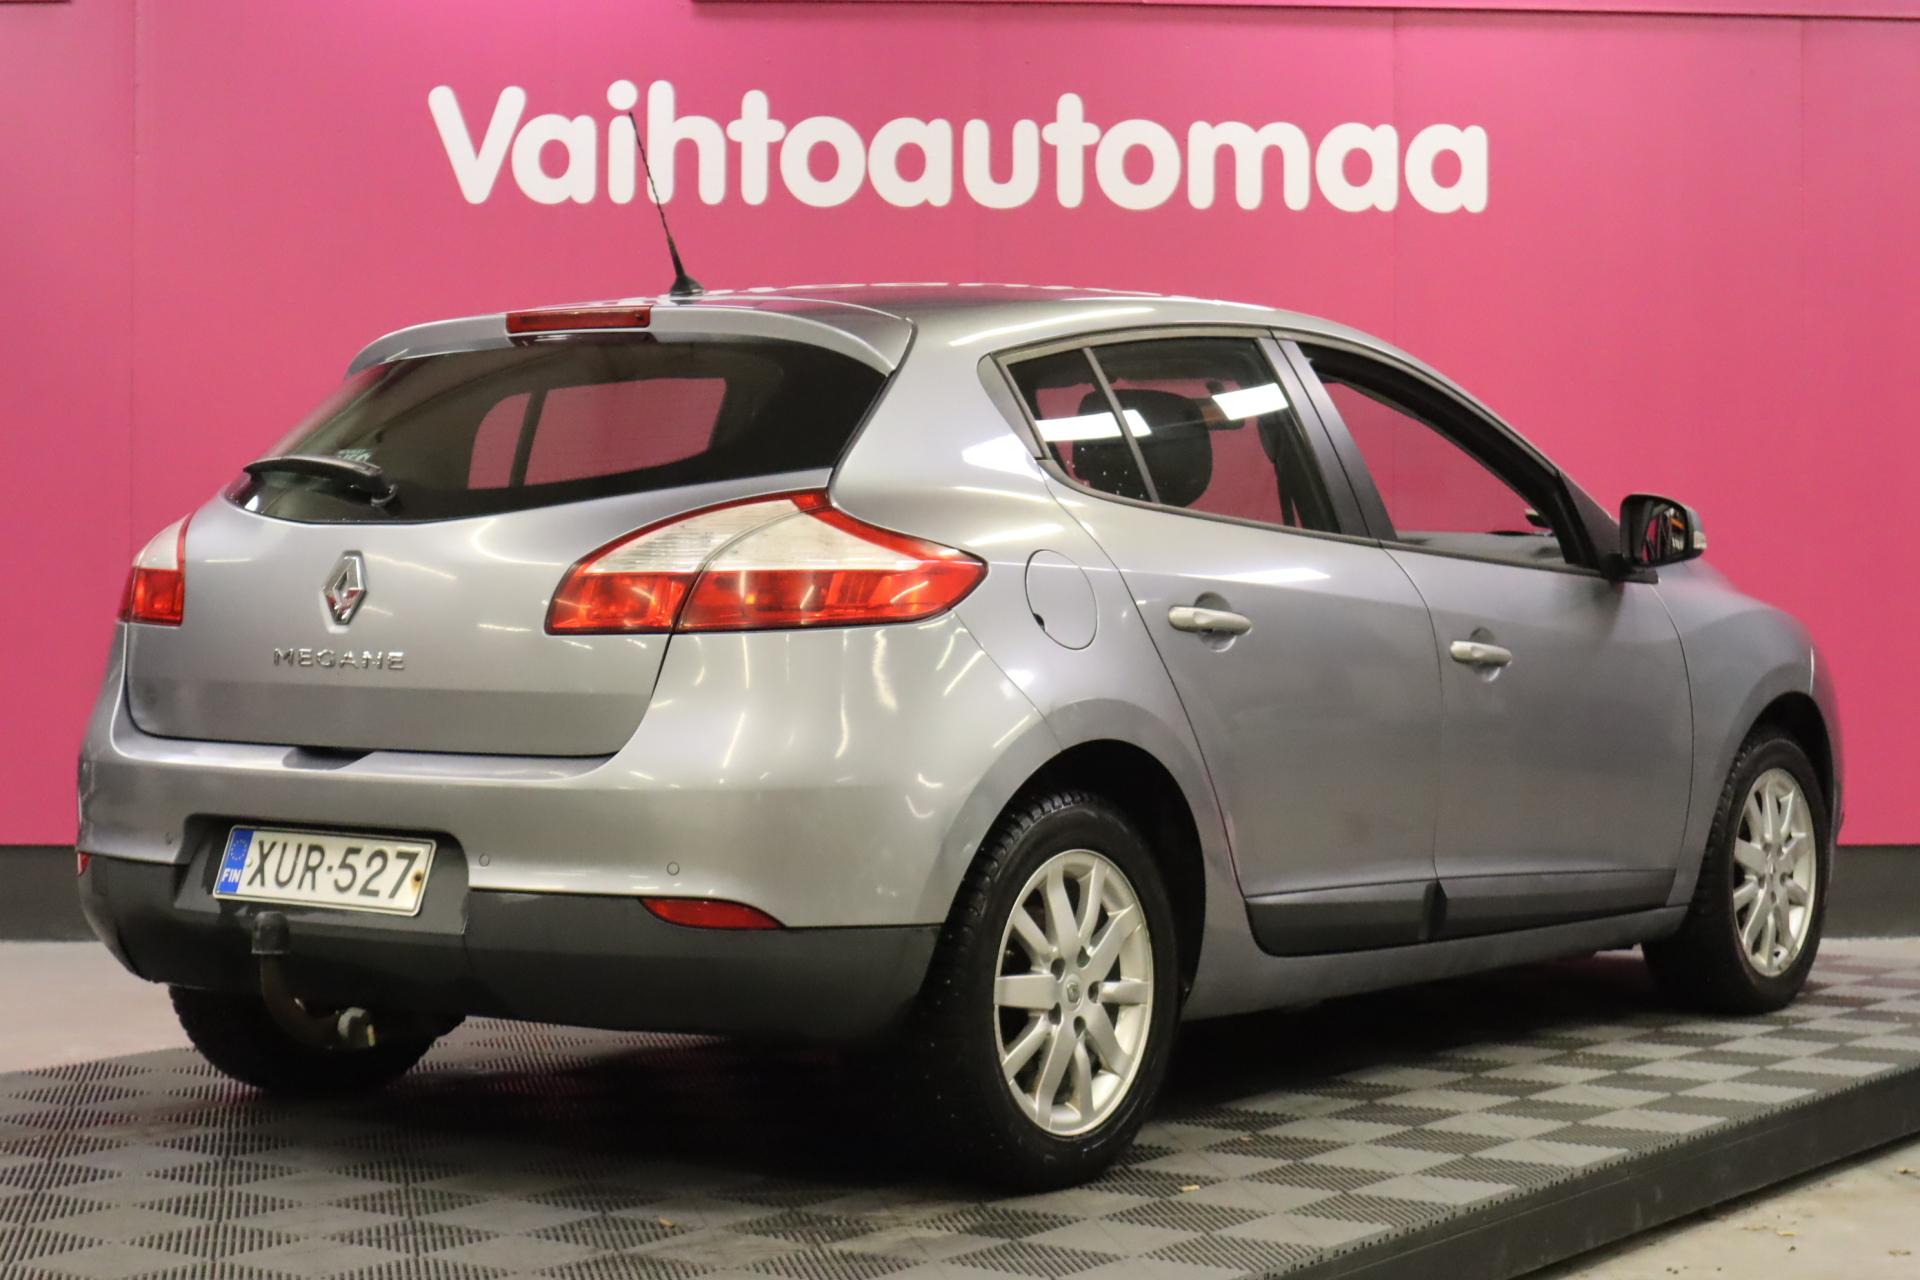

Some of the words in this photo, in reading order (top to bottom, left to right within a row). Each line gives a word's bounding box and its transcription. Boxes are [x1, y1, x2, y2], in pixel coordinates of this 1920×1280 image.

[428, 81, 1488, 213] Vaihtoautomaa
[273, 648, 405, 671] MEGANE
[221, 868, 242, 883] FIN
